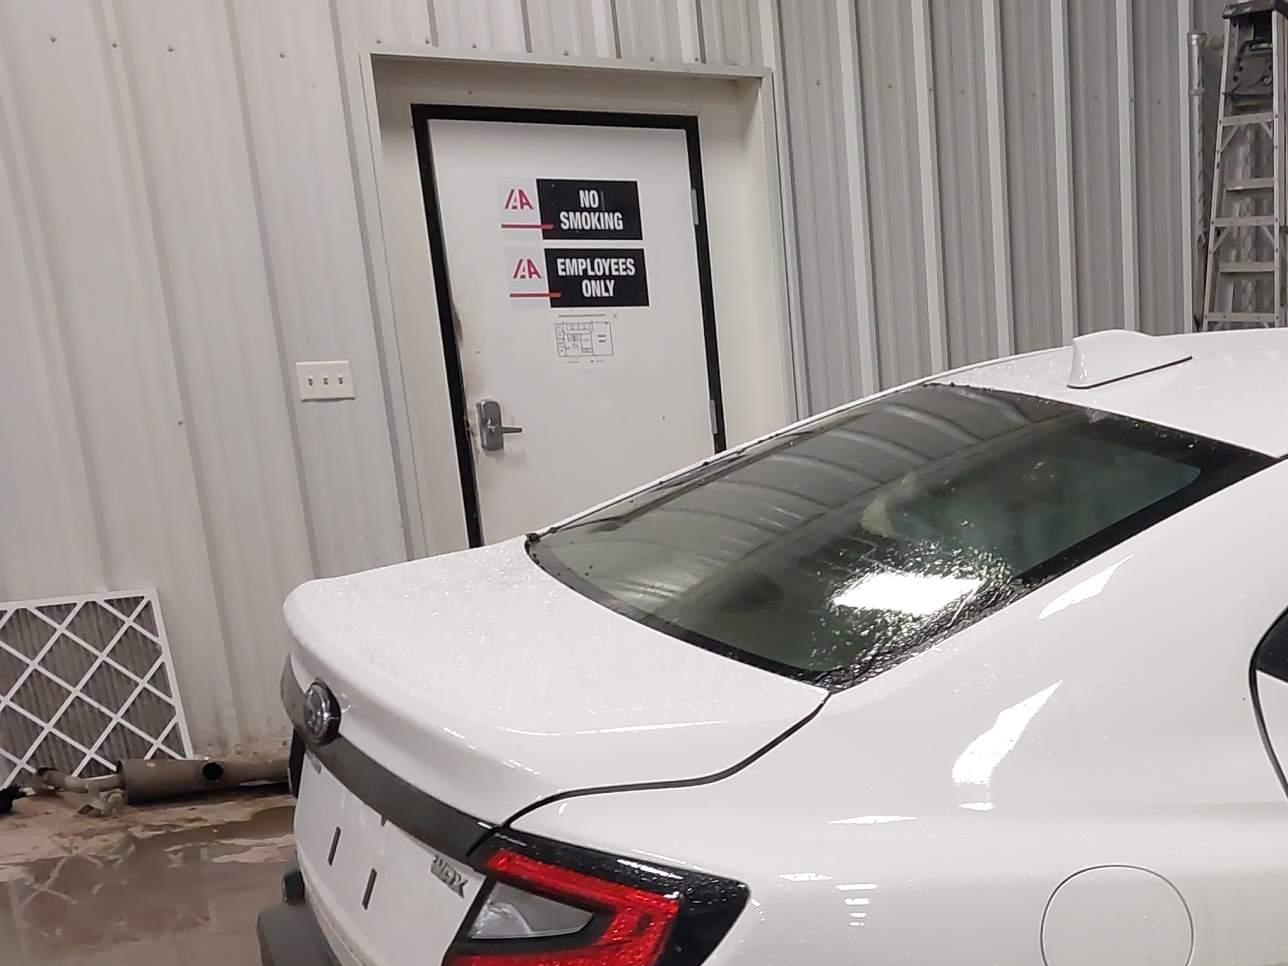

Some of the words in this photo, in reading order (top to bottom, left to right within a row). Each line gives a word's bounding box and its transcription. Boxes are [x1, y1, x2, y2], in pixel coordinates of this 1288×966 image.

[579, 189, 599, 208] NO
[559, 211, 624, 231] SMOKING
[556, 258, 636, 277] EMPLOYEES
[581, 279, 615, 298] ONLY
